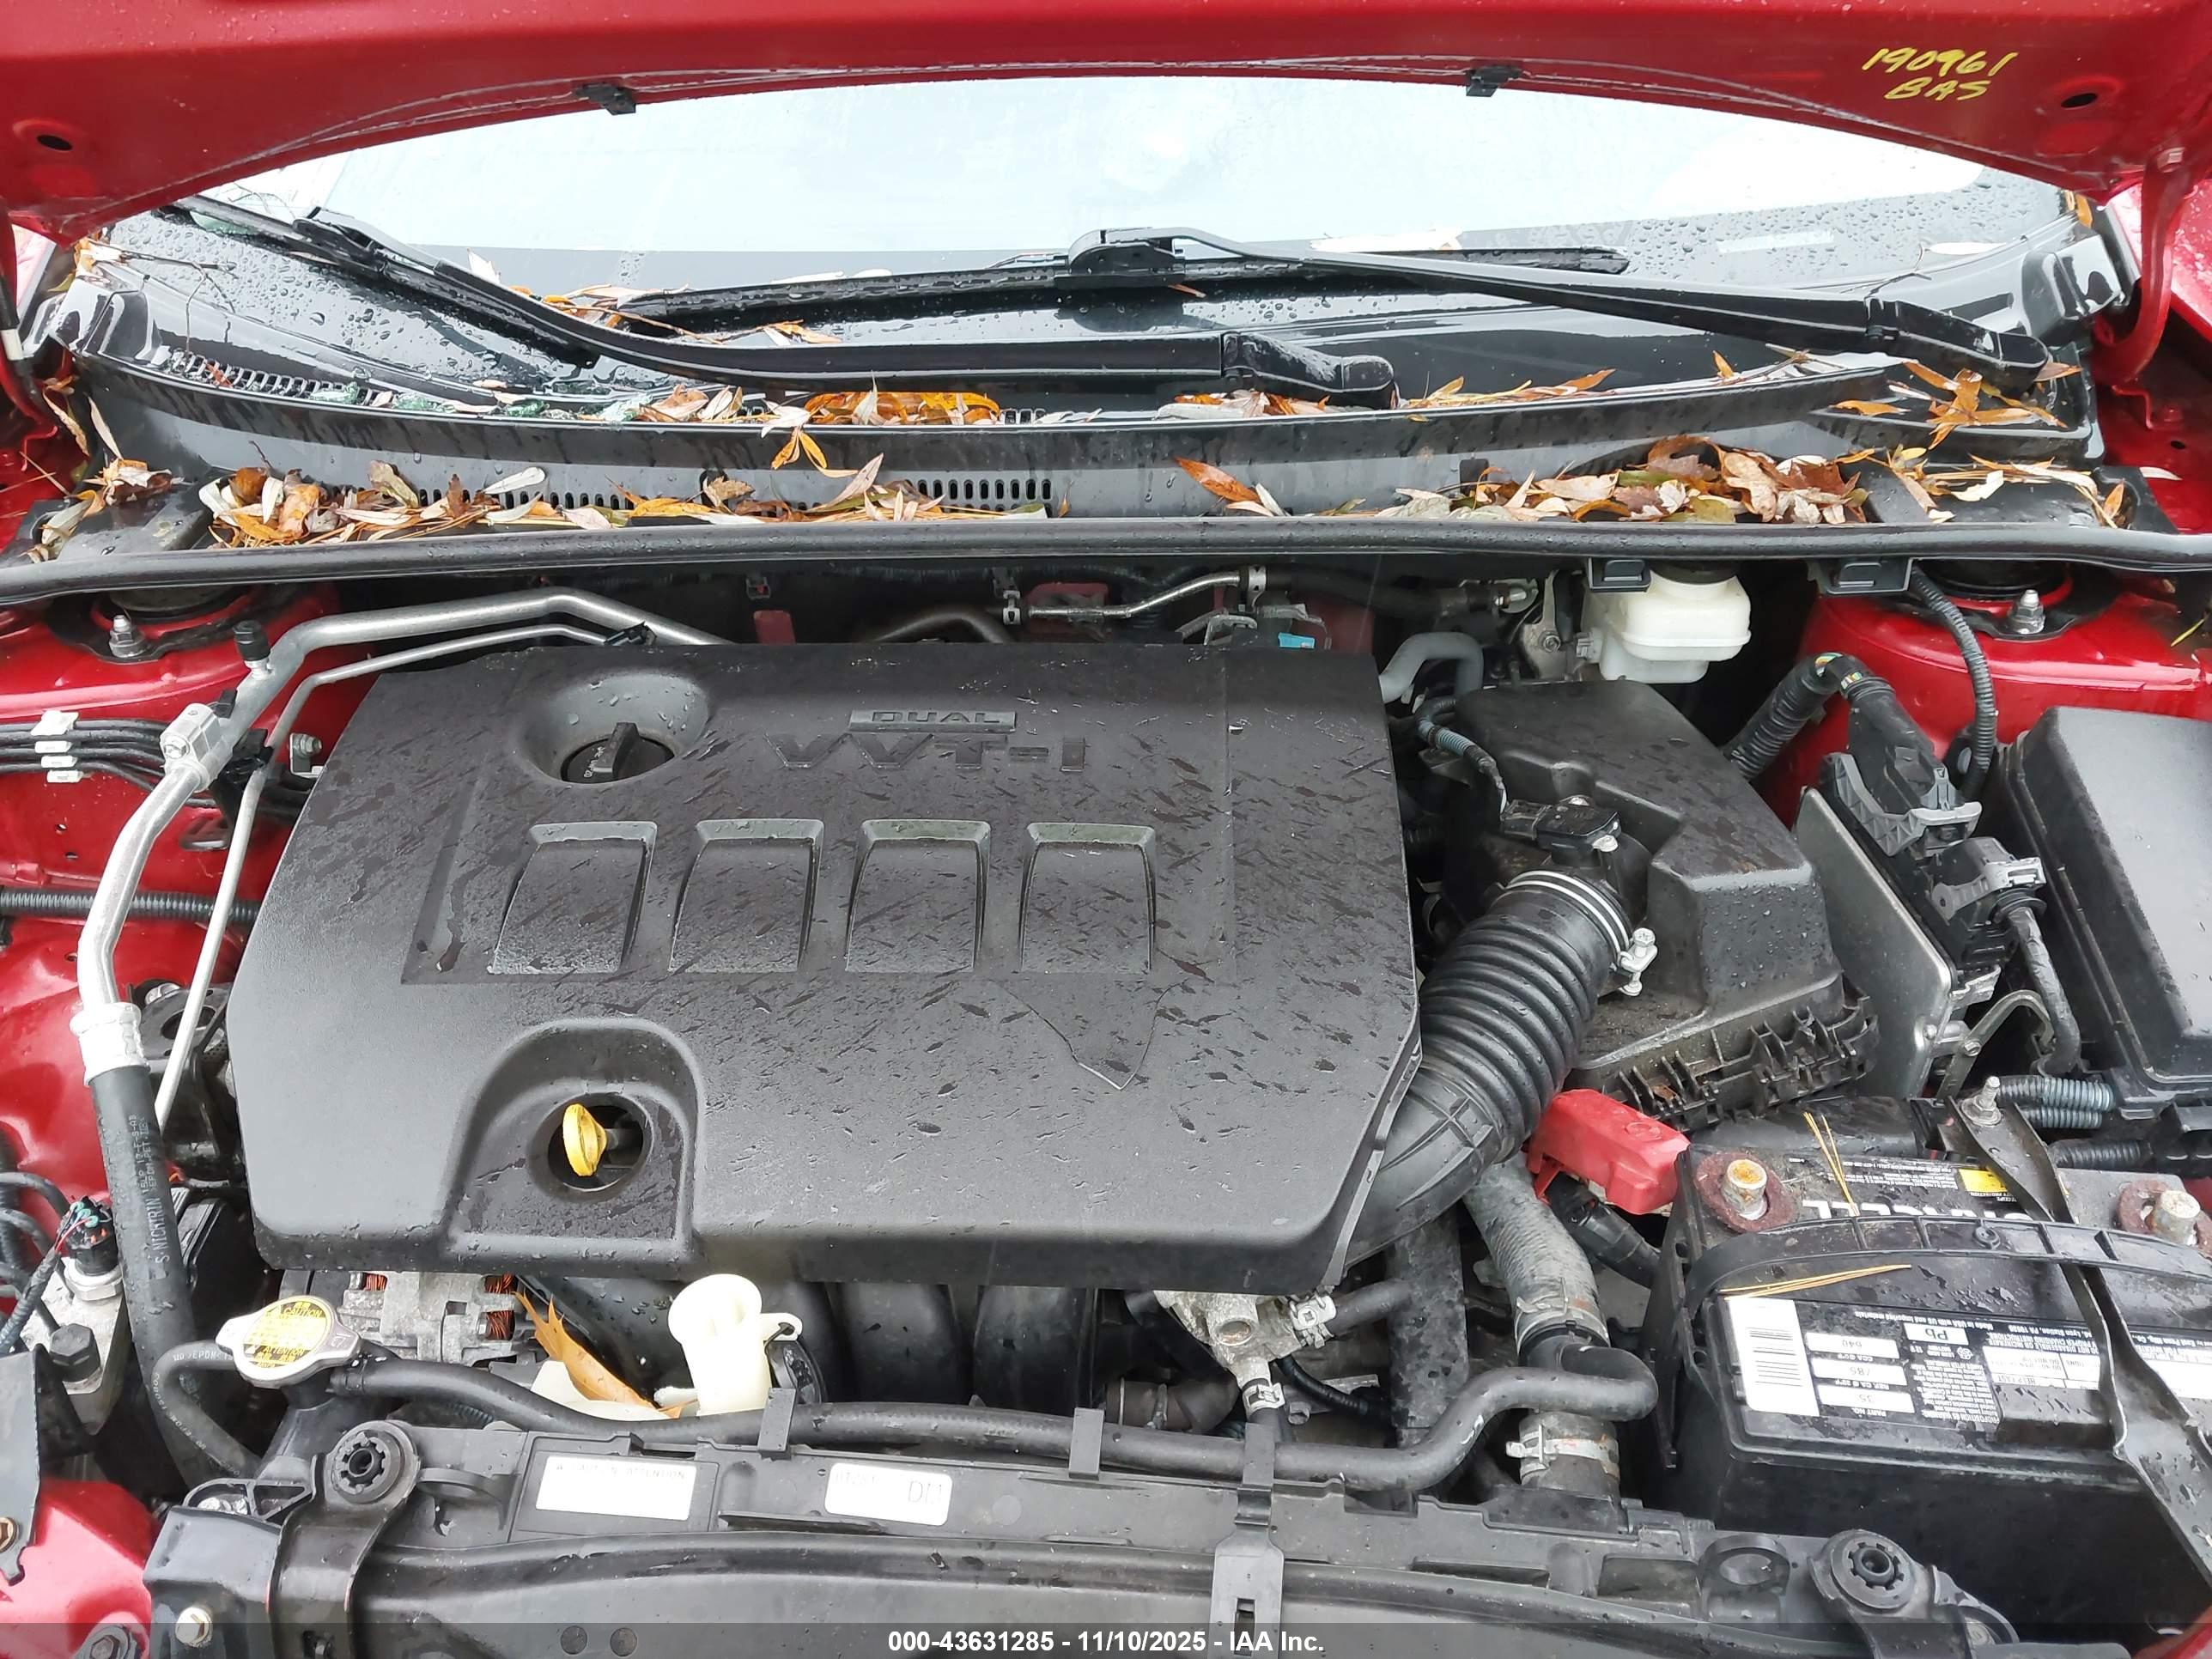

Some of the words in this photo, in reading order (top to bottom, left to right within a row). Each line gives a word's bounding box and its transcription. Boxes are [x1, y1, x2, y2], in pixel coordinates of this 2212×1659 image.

[1862, 47, 2019, 76] 190961
[1884, 76, 1991, 101] BAS
[872, 711, 1000, 724] DUAL
[283, 1307, 322, 1318] CAUTION
[1923, 1328, 1949, 1340] Pb
[262, 1346, 305, 1357] ATTENTION
[1867, 1408, 1887, 1417] PART
